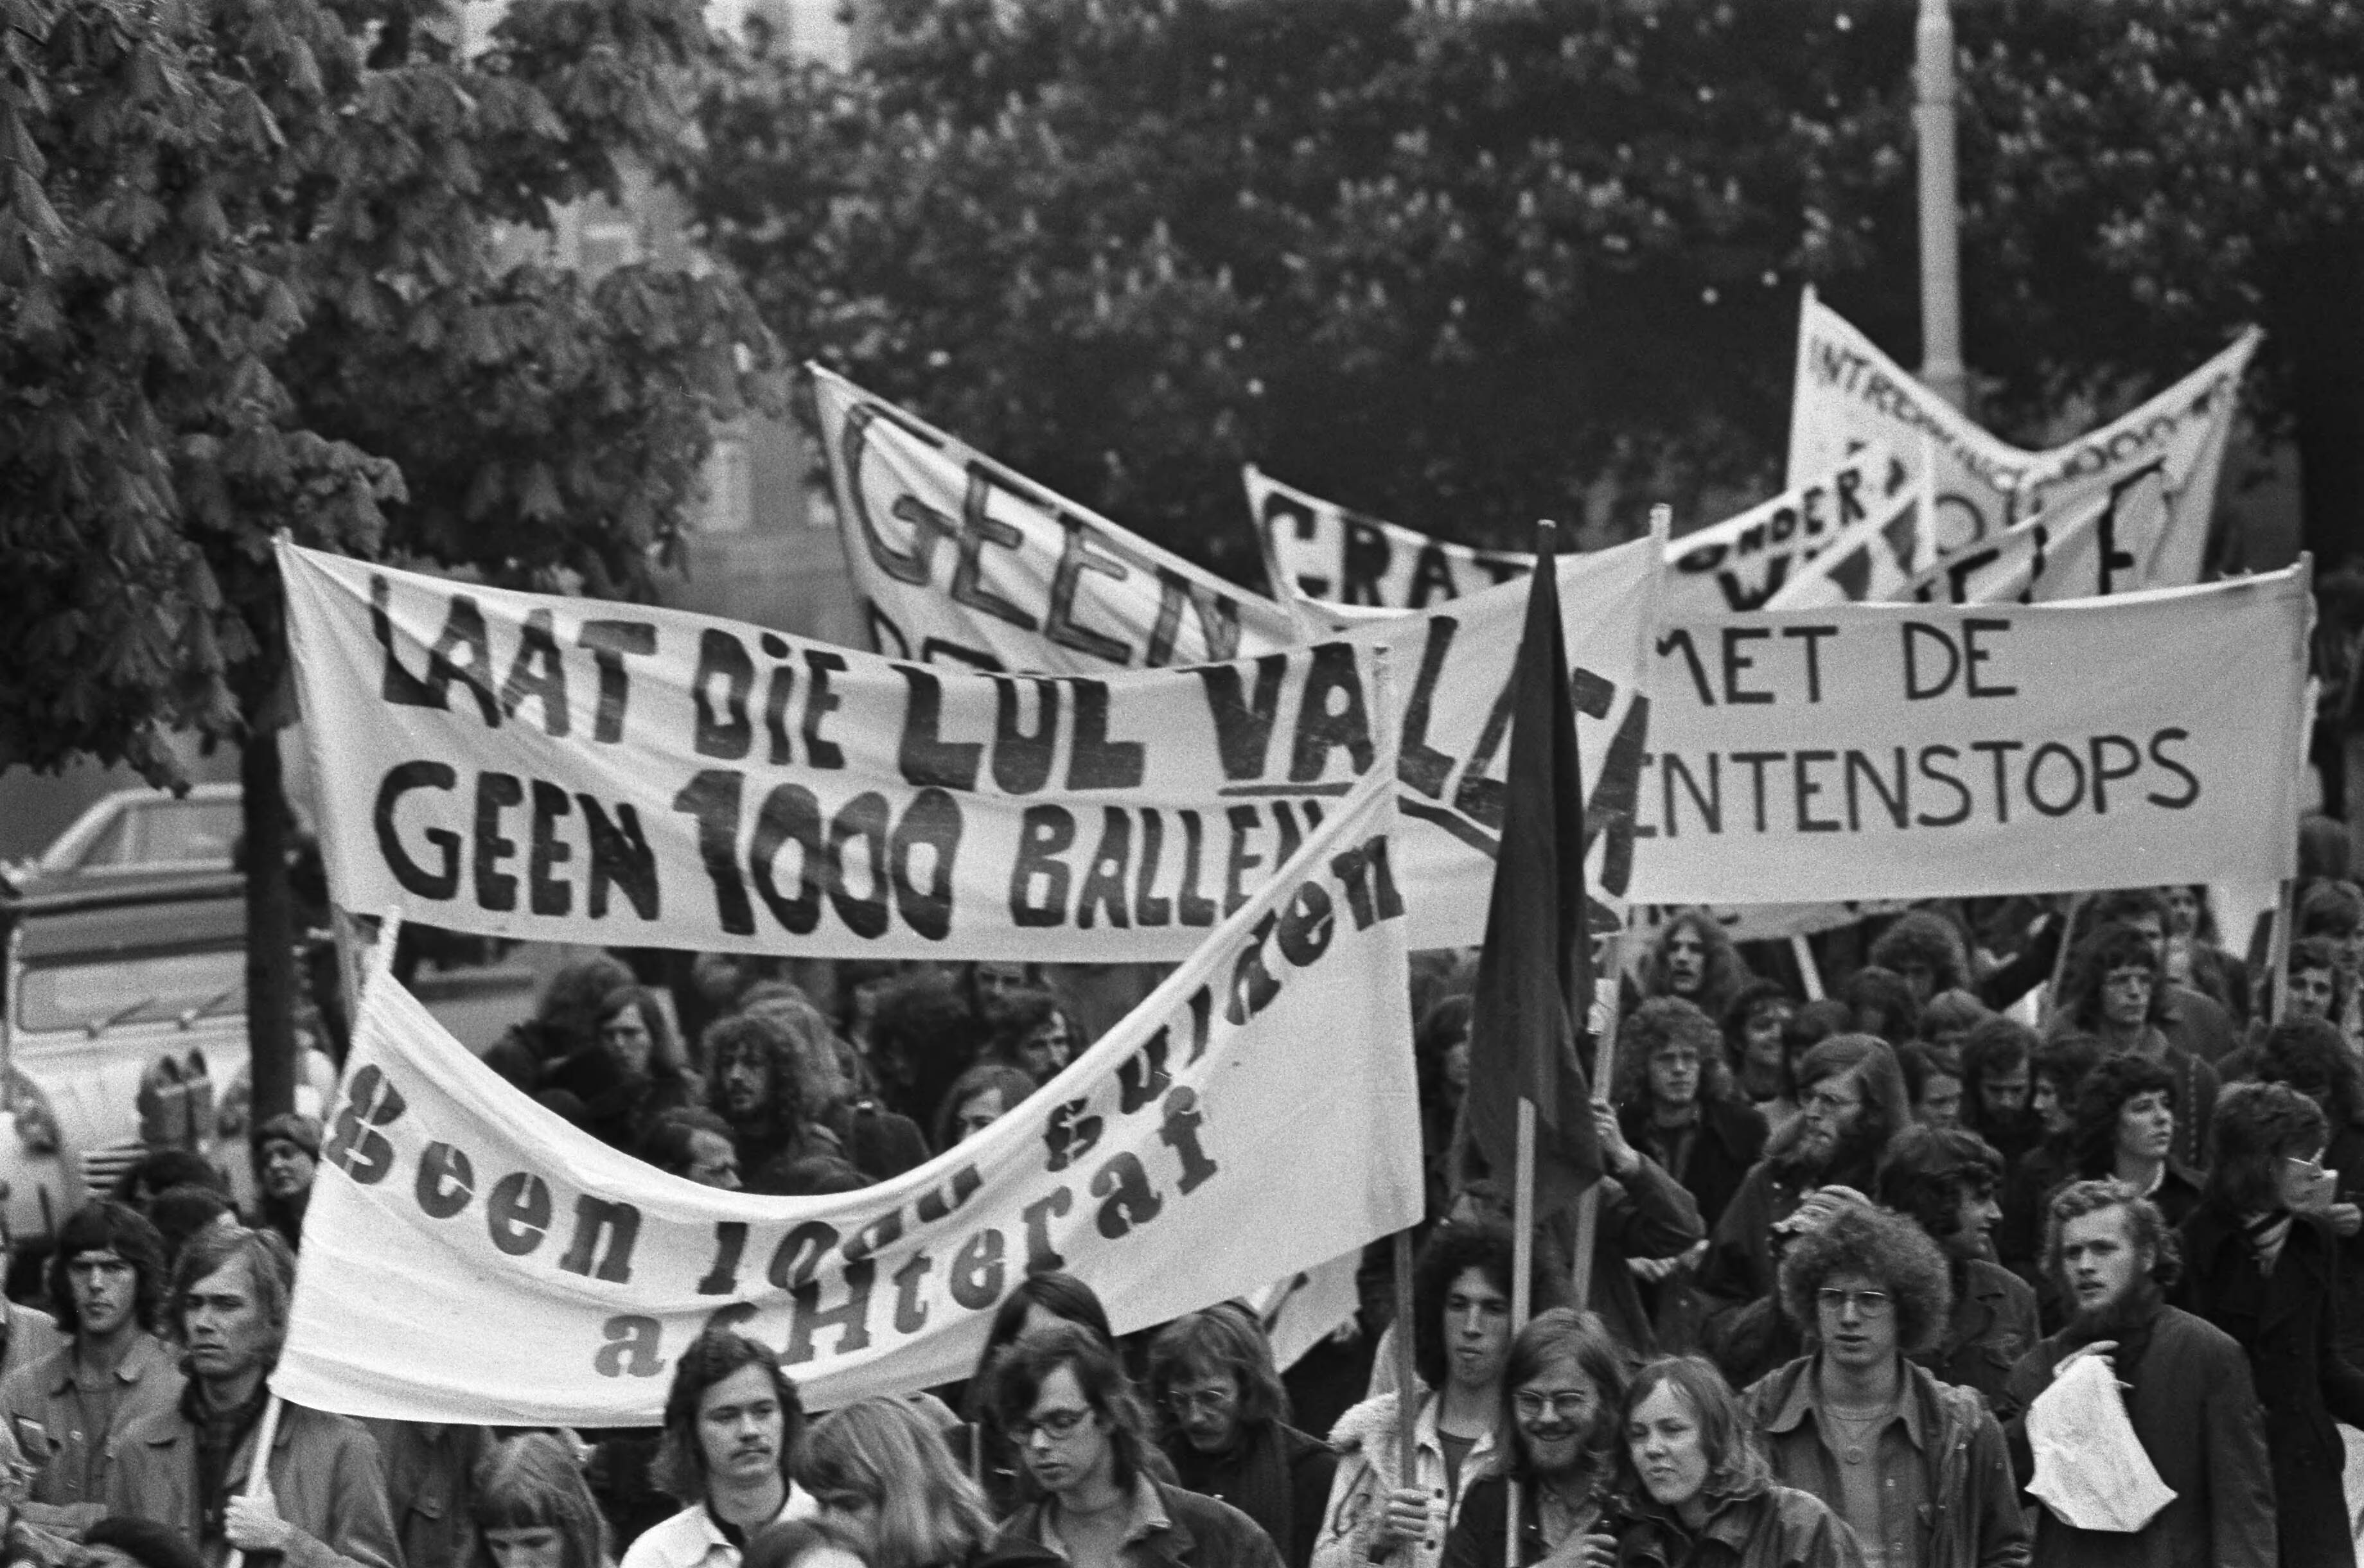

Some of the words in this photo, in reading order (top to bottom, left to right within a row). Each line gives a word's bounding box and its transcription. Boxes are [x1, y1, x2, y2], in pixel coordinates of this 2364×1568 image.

[371, 574, 657, 744] LAAT
[888, 662, 1144, 796] LUL
[1901, 618, 2017, 701] DE
[373, 759, 660, 920] GEEN
[673, 769, 963, 940] 1000
